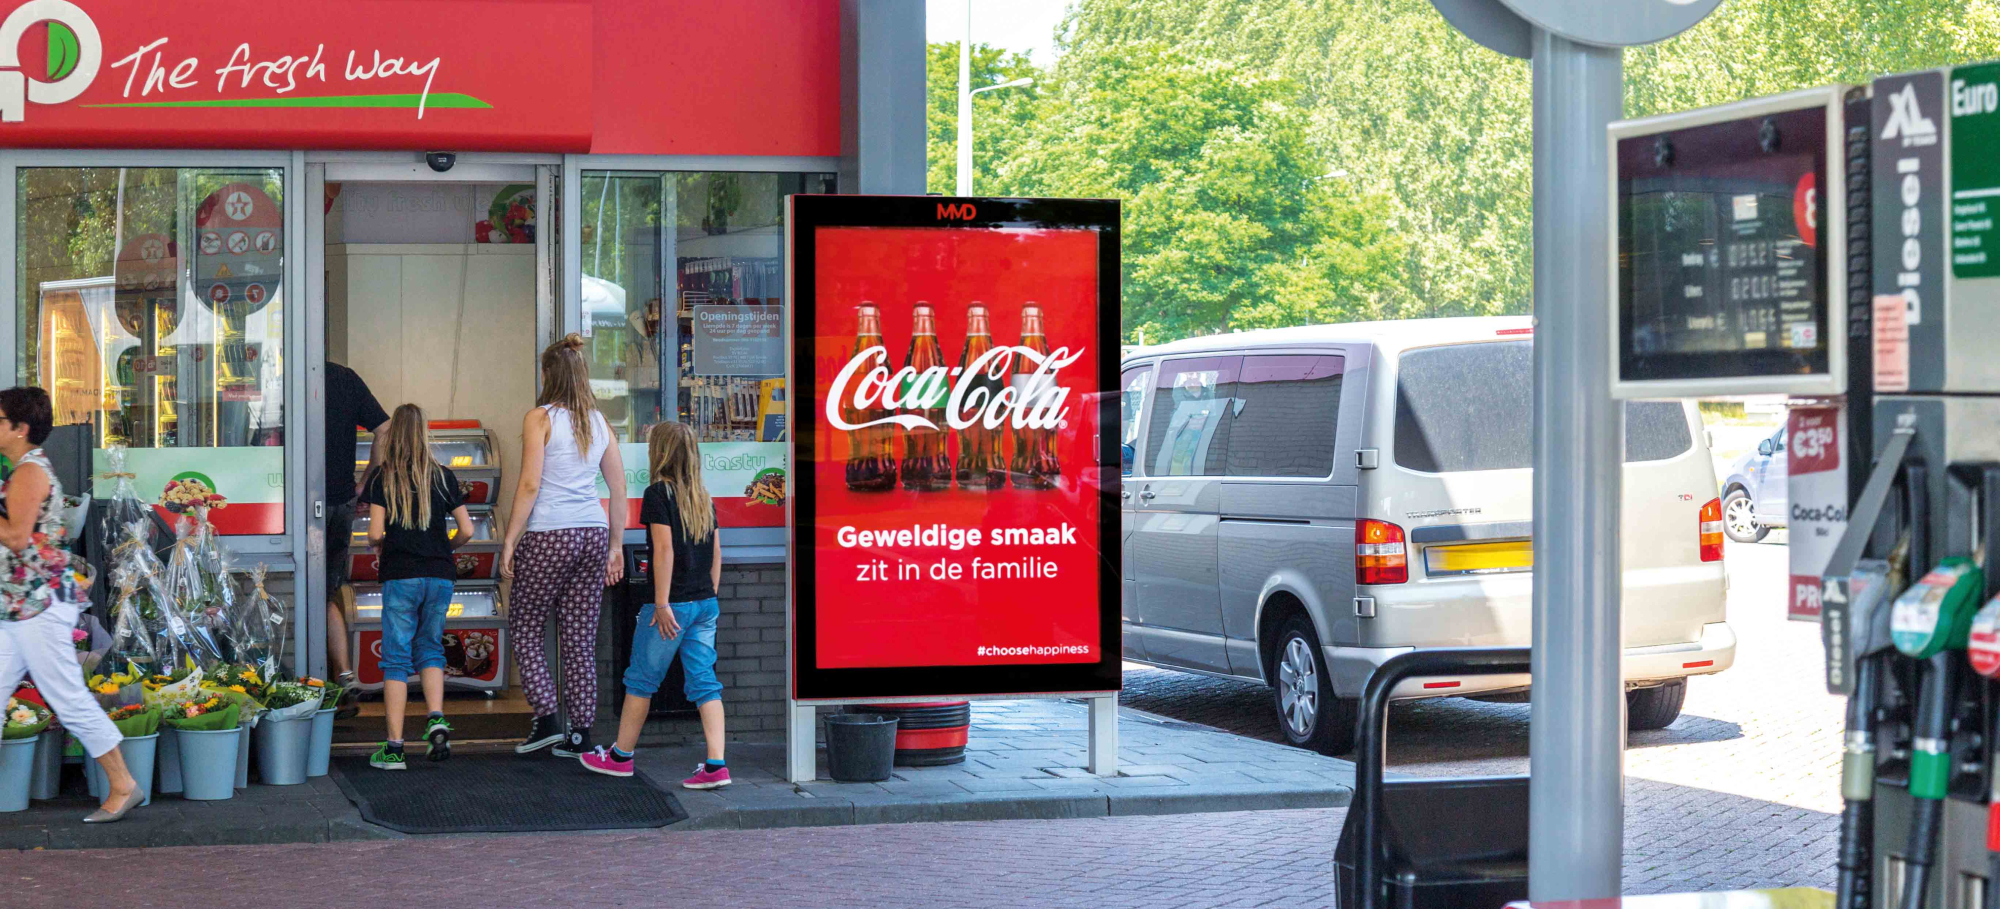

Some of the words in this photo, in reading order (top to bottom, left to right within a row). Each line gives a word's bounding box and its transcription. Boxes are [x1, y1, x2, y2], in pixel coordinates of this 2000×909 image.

[112, 37, 198, 98] The
[215, 43, 326, 94] fresh
[345, 48, 441, 120] Way
[1952, 78, 1998, 117] Euro
[1880, 82, 1937, 140] XL
[937, 203, 977, 220] MMD
[1897, 157, 1922, 326] Diesel
[700, 311, 779, 322] Openingstijden
[826, 345, 1085, 431] Coca-Cola
[704, 454, 765, 478] tasty
[1792, 503, 1848, 521] Coca-Col
[837, 524, 982, 550] Geweldige
[990, 523, 1077, 545] smaak
[856, 559, 888, 581] zit
[898, 558, 920, 580] in
[930, 558, 963, 579] de
[972, 557, 1058, 579] familie
[977, 643, 1090, 657] #choosehappiness
